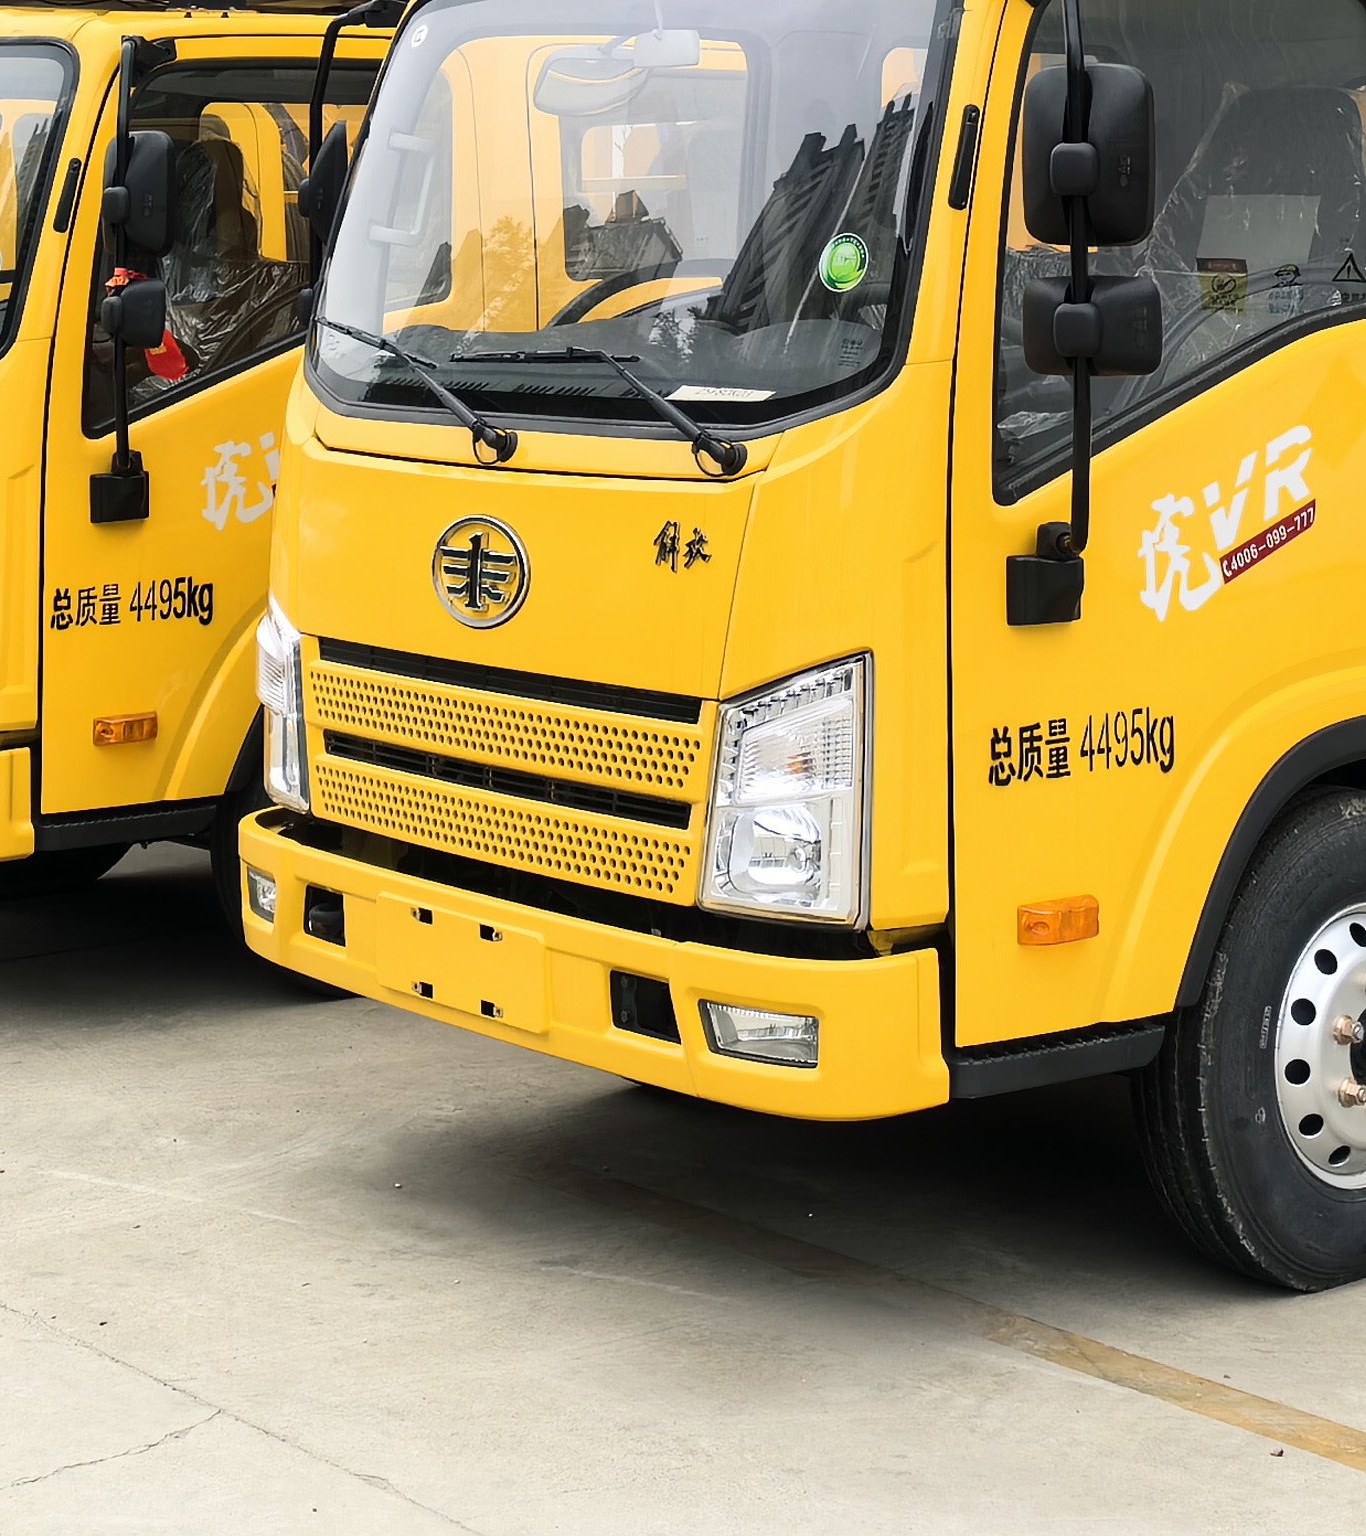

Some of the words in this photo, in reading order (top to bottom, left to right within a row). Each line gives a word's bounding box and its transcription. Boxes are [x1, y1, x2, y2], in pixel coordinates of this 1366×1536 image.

[50, 583, 121, 630] 总质量
[129, 576, 213, 625] 4495kg
[988, 718, 1071, 786] 总质量
[1079, 707, 1174, 772] 4495kg
